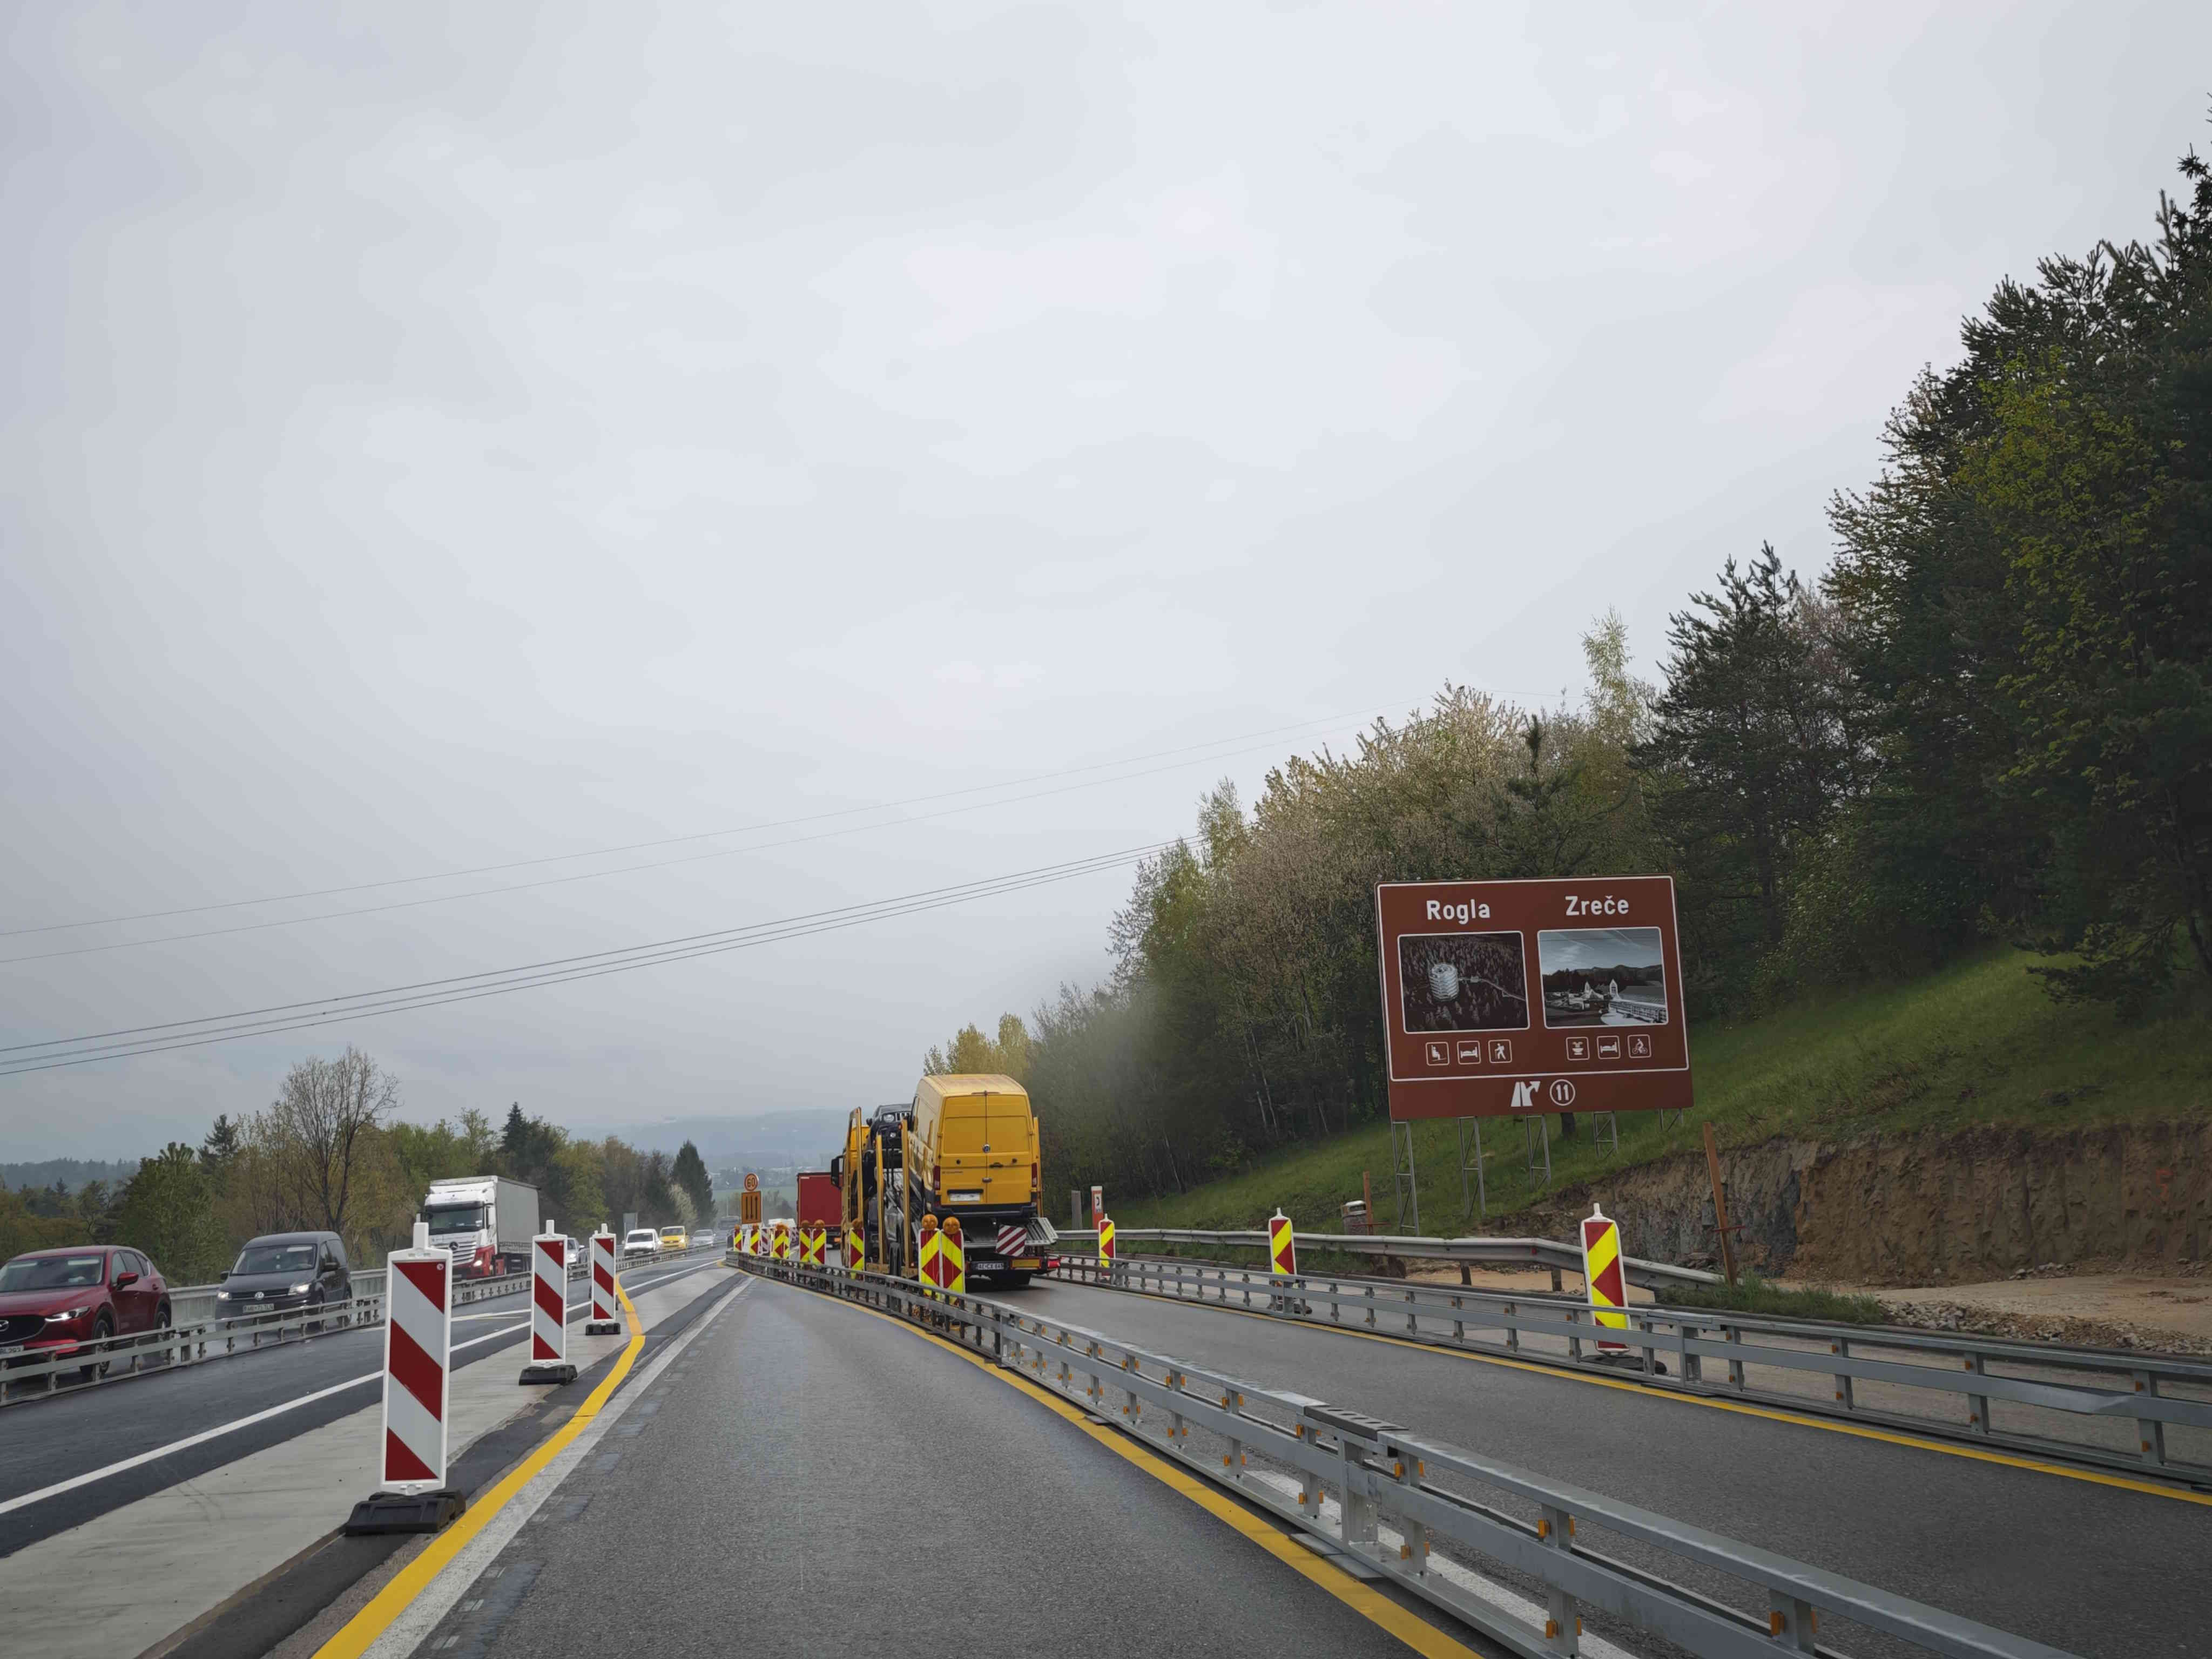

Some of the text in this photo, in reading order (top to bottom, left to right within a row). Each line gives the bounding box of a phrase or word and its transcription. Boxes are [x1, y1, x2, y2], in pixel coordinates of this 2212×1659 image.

[1426, 899, 1491, 925] Rogla
[1565, 895, 1629, 916] Zreče
[1556, 1084, 1569, 1101] 11
